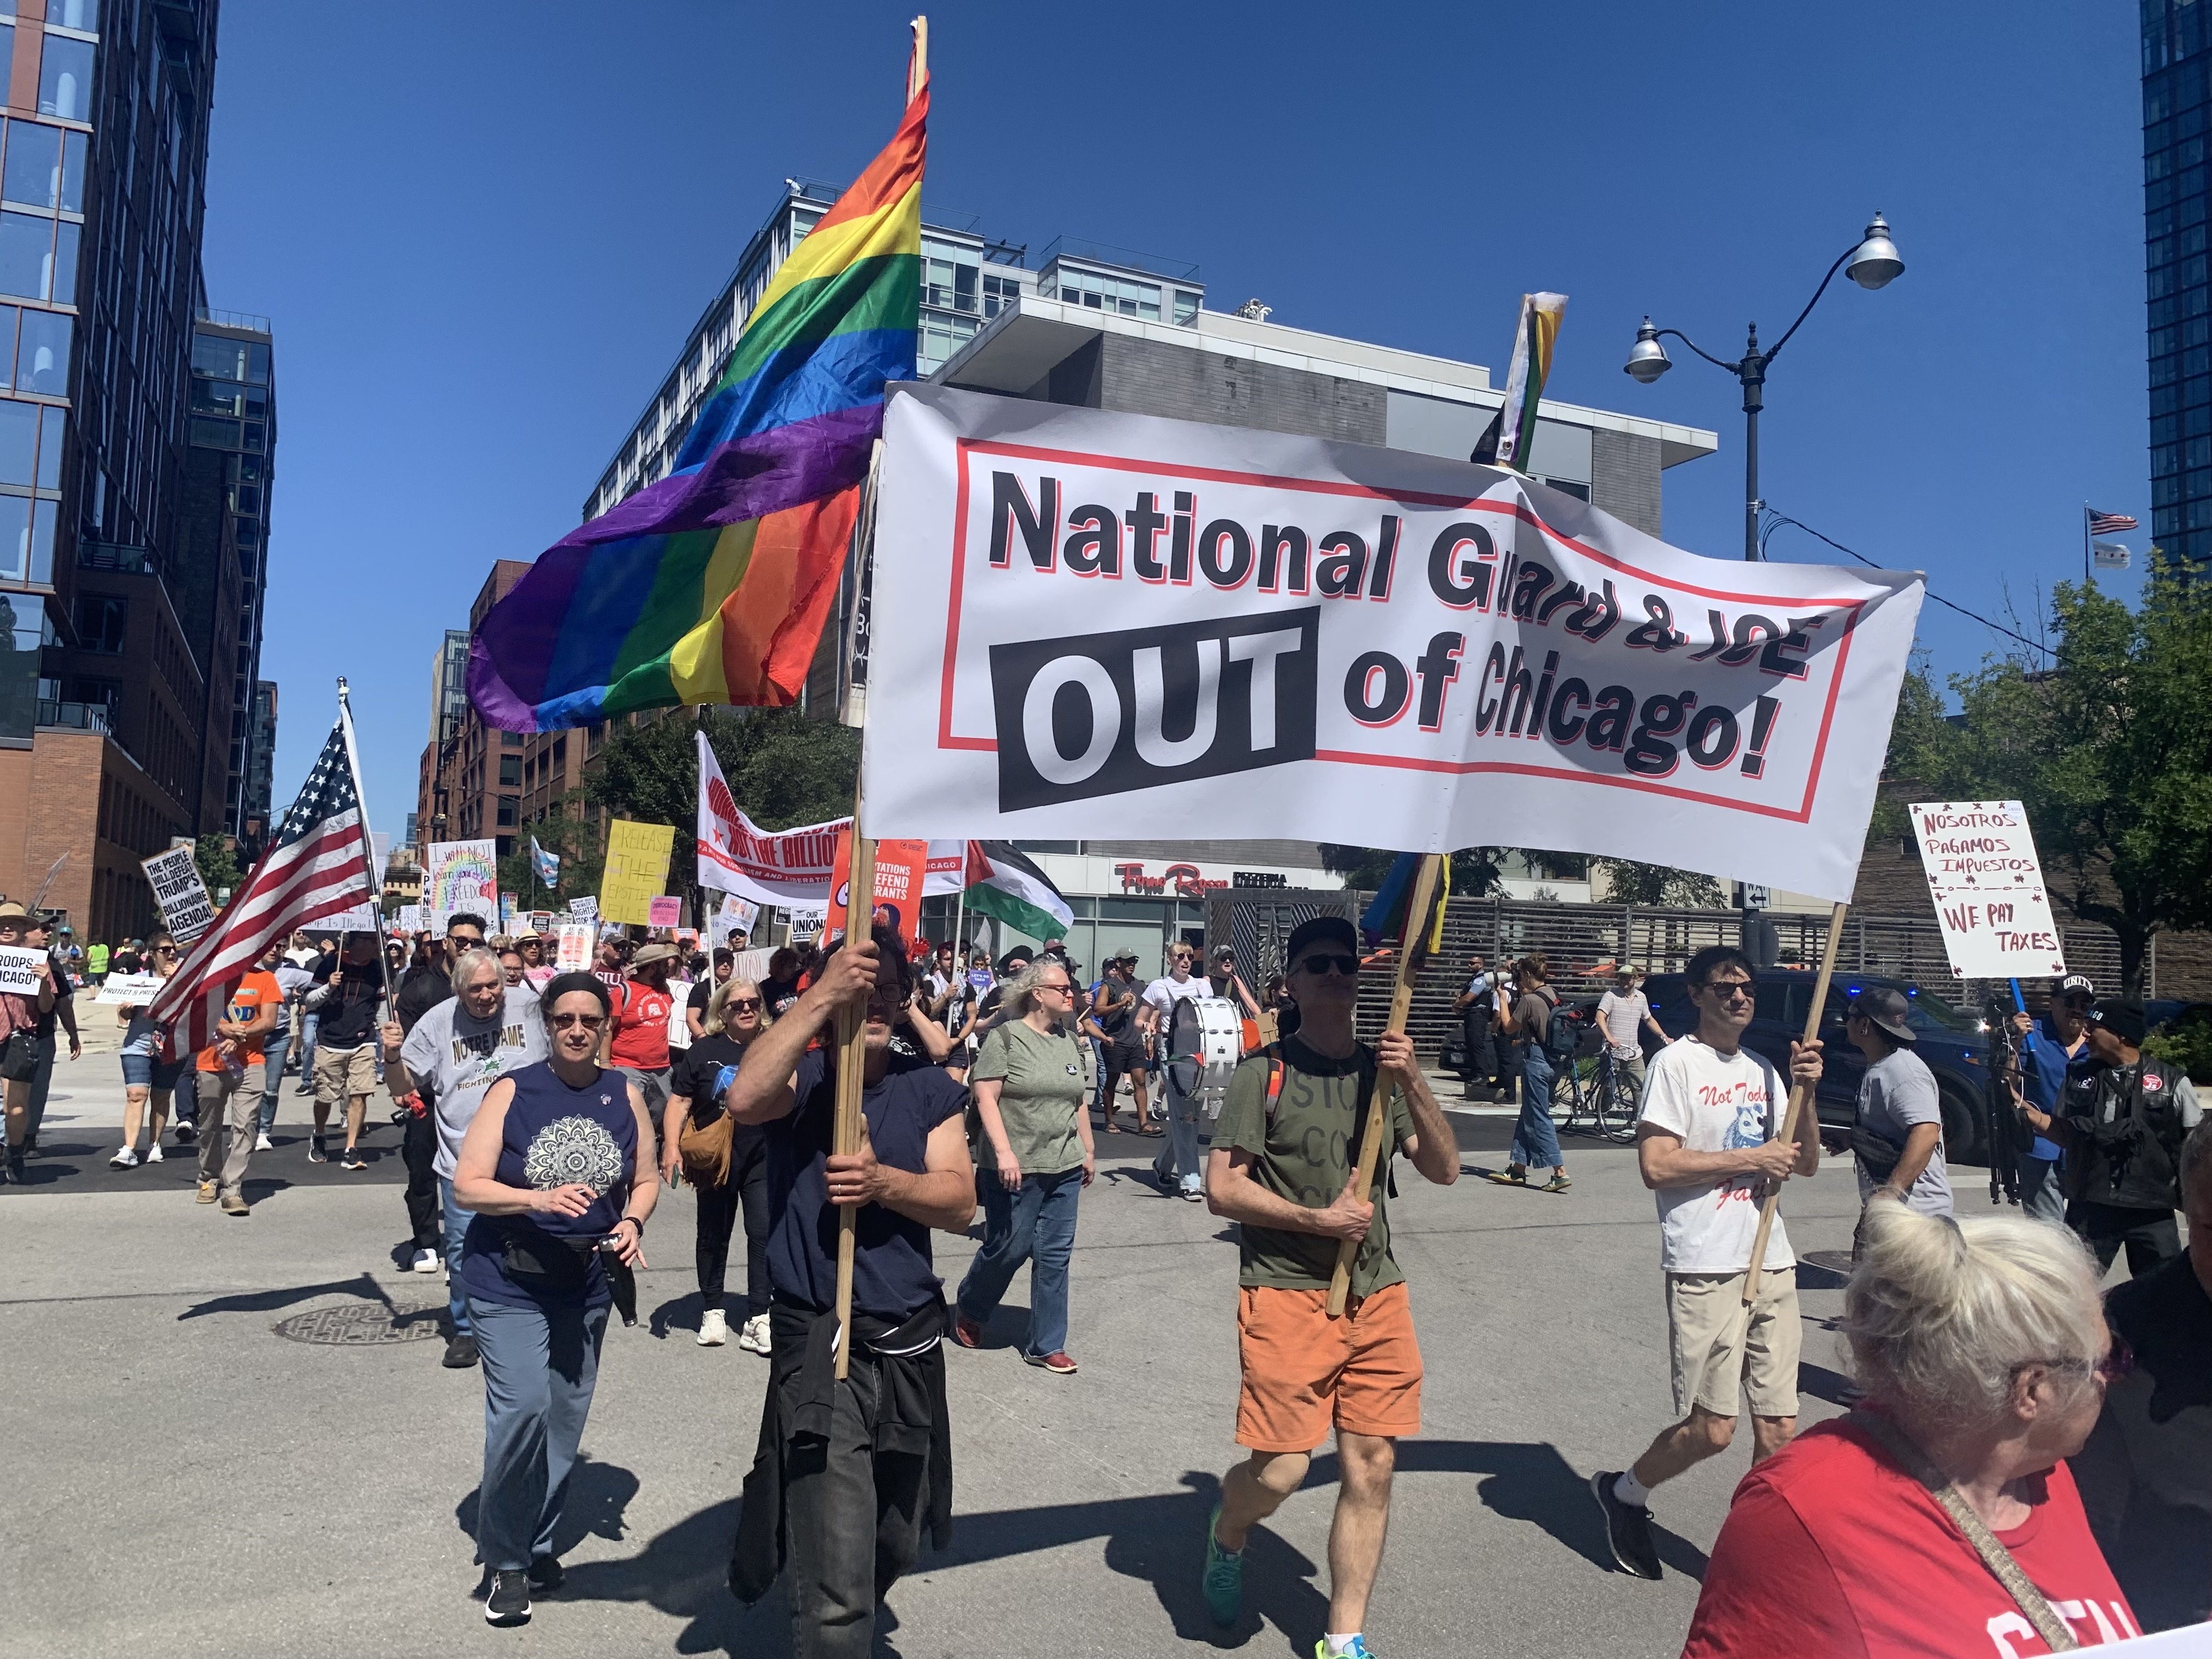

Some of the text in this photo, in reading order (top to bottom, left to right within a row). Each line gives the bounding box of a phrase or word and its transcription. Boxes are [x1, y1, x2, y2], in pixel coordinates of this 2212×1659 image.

[989, 471, 1402, 601] National
[1428, 522, 1620, 642] Guard
[1624, 595, 1689, 653] &
[1023, 627, 1781, 785] OUT of Chicago!
[1924, 814, 2017, 835] NOSOTROS
[622, 826, 672, 853] RELEASE
[1925, 838, 2010, 854] PAGAMOS
[431, 844, 493, 862] I will NOT
[749, 837, 780, 867] THE
[147, 850, 189, 876] THE PEOPLE
[618, 854, 657, 882] THE
[876, 862, 911, 876] TATIONS
[927, 861, 956, 870] ICAGO
[1939, 858, 2035, 873] IMPUESTOS
[152, 862, 194, 887] WILL DEFEAT
[874, 873, 909, 889] EFEND
[156, 873, 200, 900] TRUMP'S
[445, 883, 490, 901] FREEDOM
[163, 890, 208, 917] BILLIONAIRE
[460, 902, 475, 912] IS
[573, 906, 596, 917] RIGHTS!
[168, 904, 215, 933] AGENDA!
[576, 917, 589, 925] STOP
[1943, 902, 2014, 933] WE PAY
[1995, 931, 2057, 951] TAXES
[0, 955, 33, 969] ROOPS
[0, 970, 36, 985] ICAGO!
[595, 972, 622, 985] SIU
[2063, 975, 2094, 994] UNITY
[453, 1024, 526, 1065] NOTRE DAME
[1291, 1070, 1357, 1111] STO
[1699, 1082, 1774, 1106] Not Toda
[1302, 1125, 1347, 1170] CO
